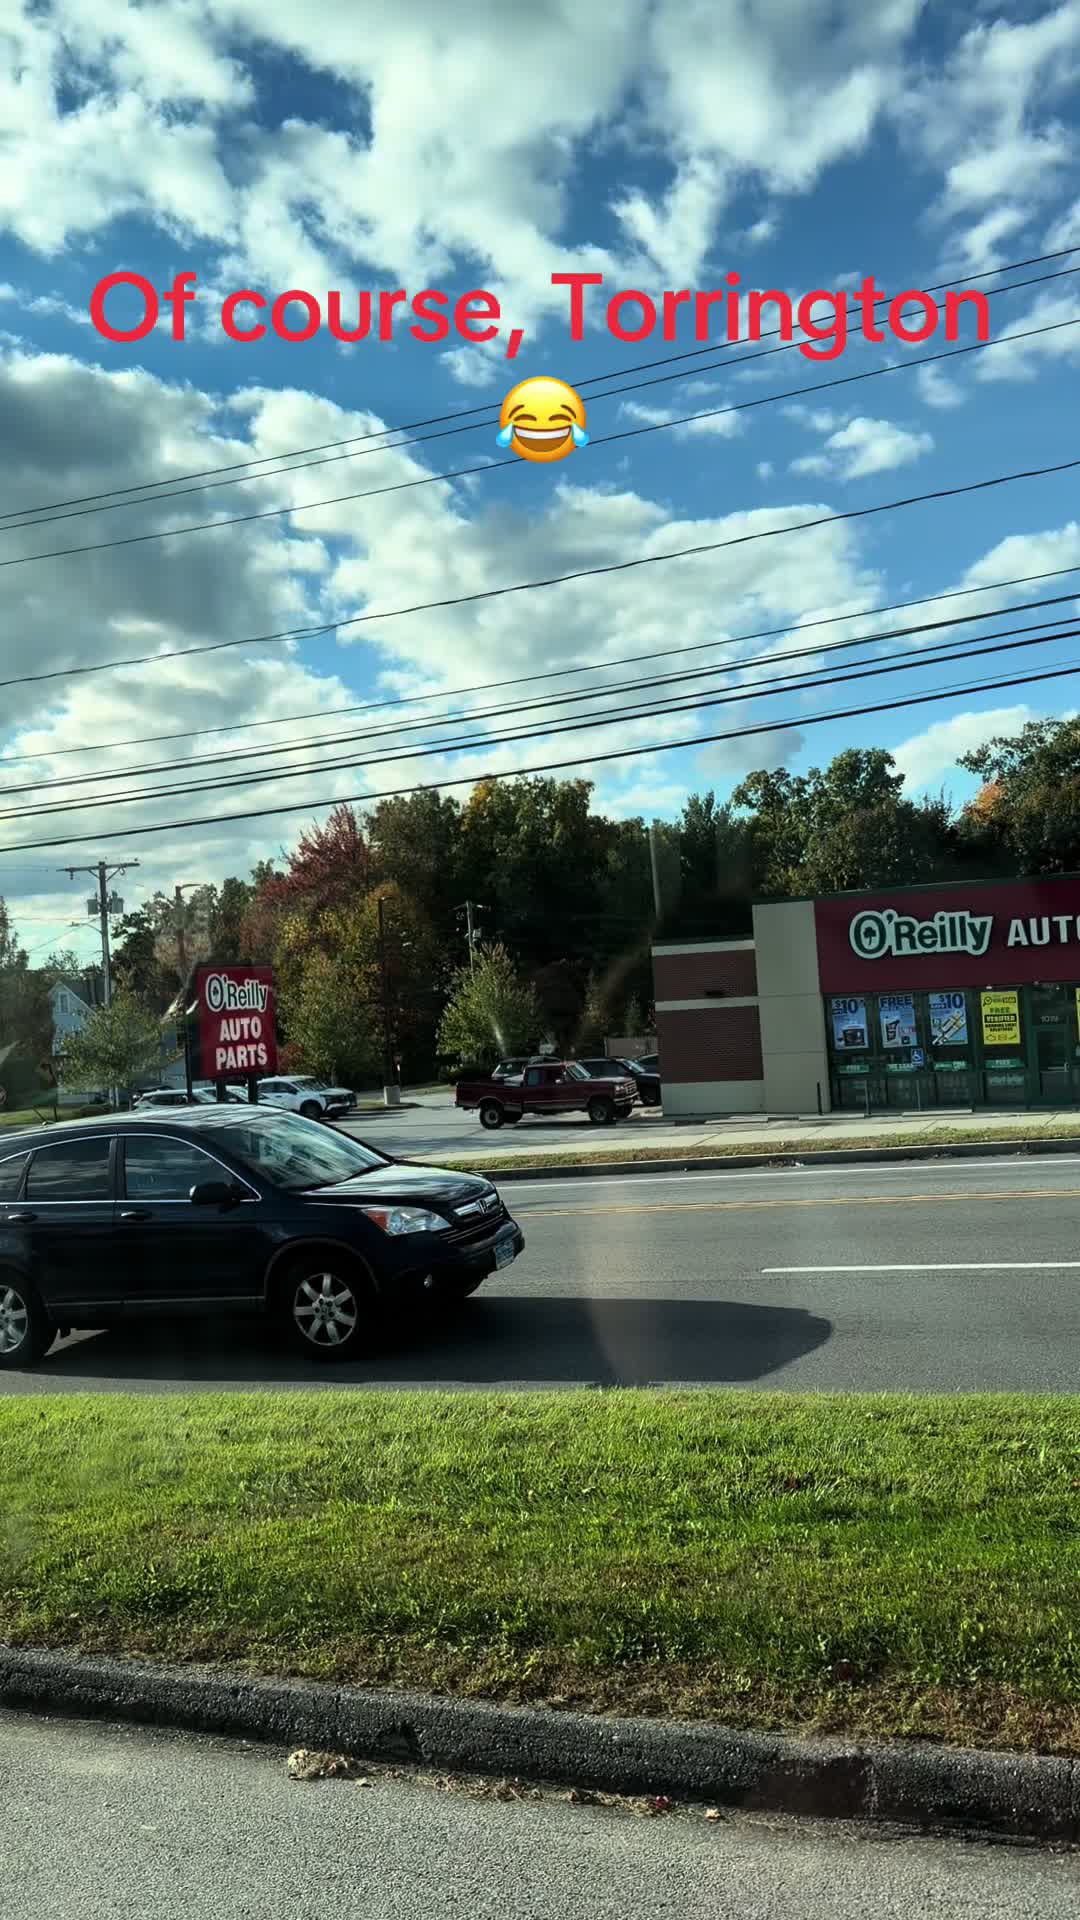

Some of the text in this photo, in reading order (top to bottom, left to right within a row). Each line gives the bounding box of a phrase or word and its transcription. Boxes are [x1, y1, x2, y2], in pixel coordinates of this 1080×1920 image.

[850, 910, 1080, 958] O'Reilly AUT
[206, 973, 268, 1013] O'Reilly
[879, 995, 912, 1008] FREE
[939, 993, 964, 1009] $10
[219, 1016, 262, 1042] AUTO
[215, 1043, 268, 1071] PARTS
